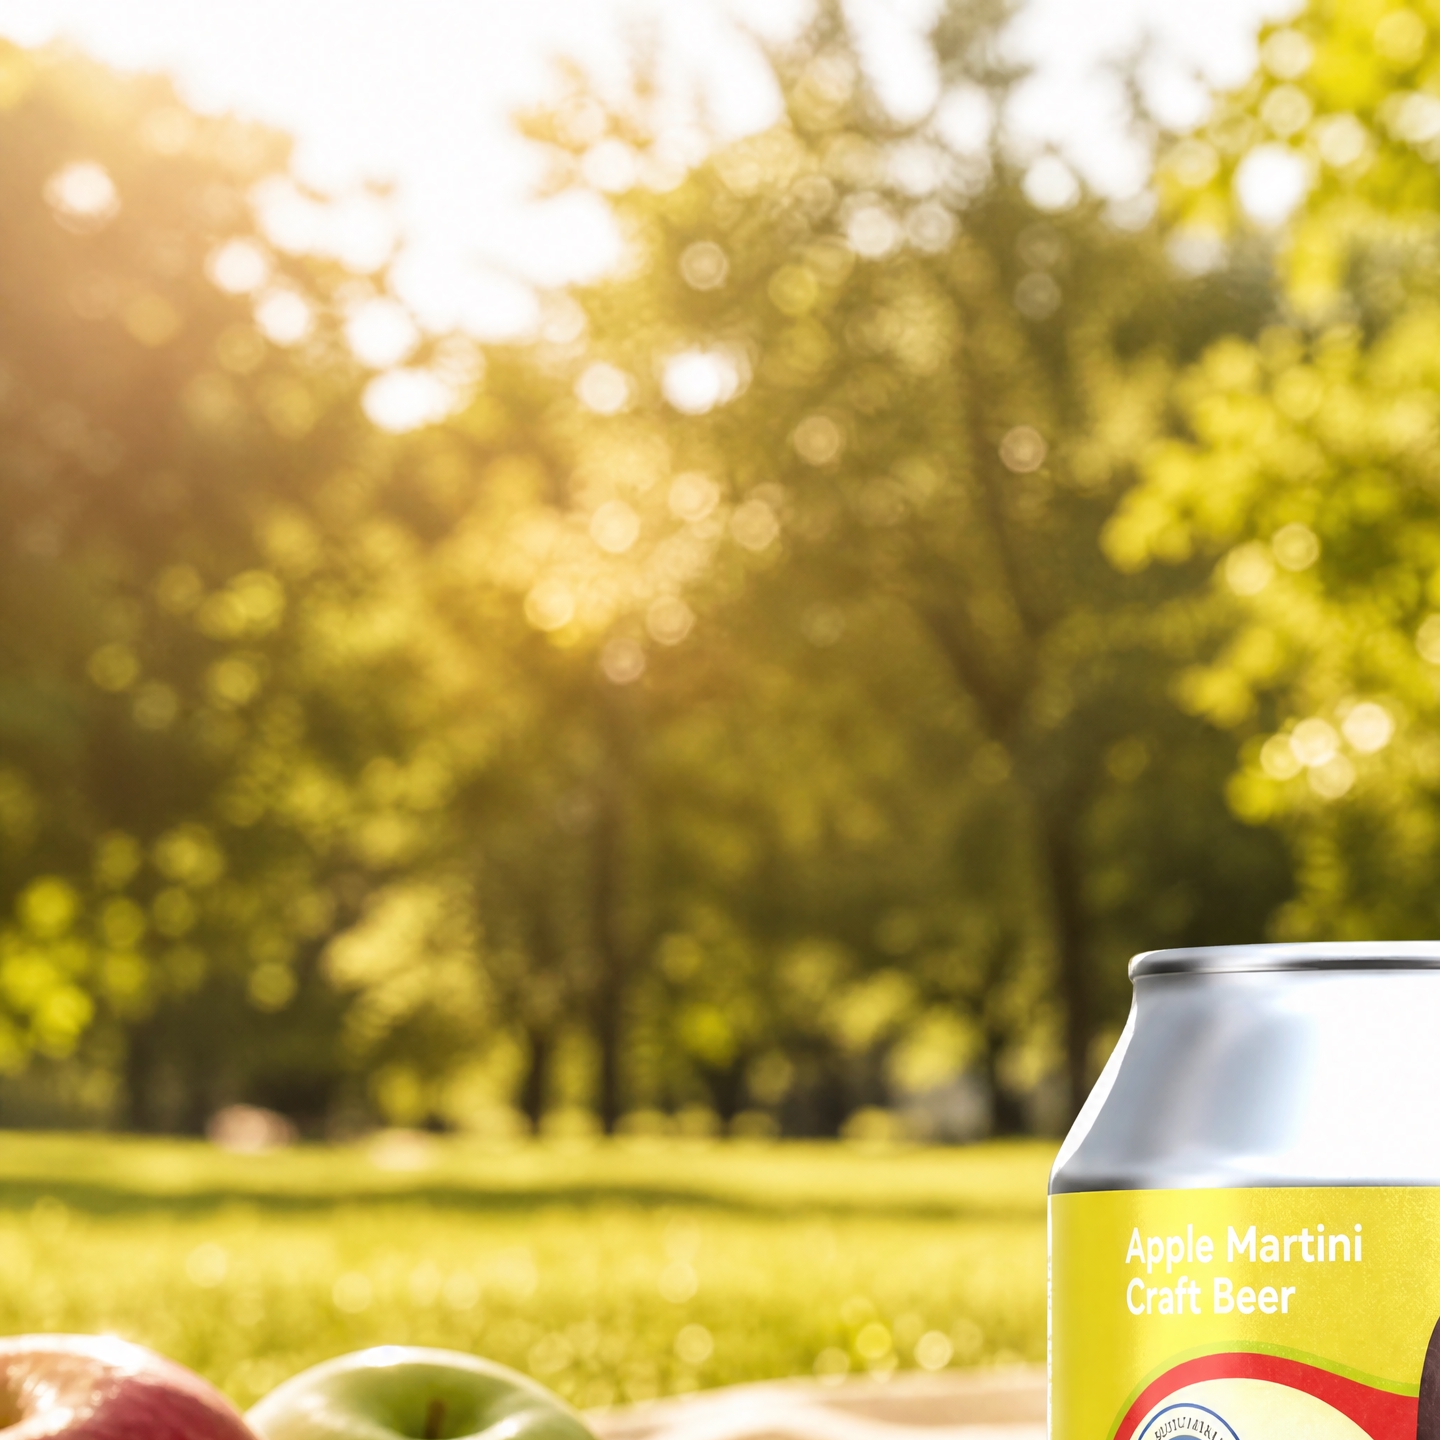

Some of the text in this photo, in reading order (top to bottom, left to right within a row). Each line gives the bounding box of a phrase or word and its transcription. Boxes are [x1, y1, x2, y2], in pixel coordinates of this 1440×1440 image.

[1125, 1223, 1363, 1274] Apple Martini
[1126, 1275, 1296, 1315] Craft Beer
